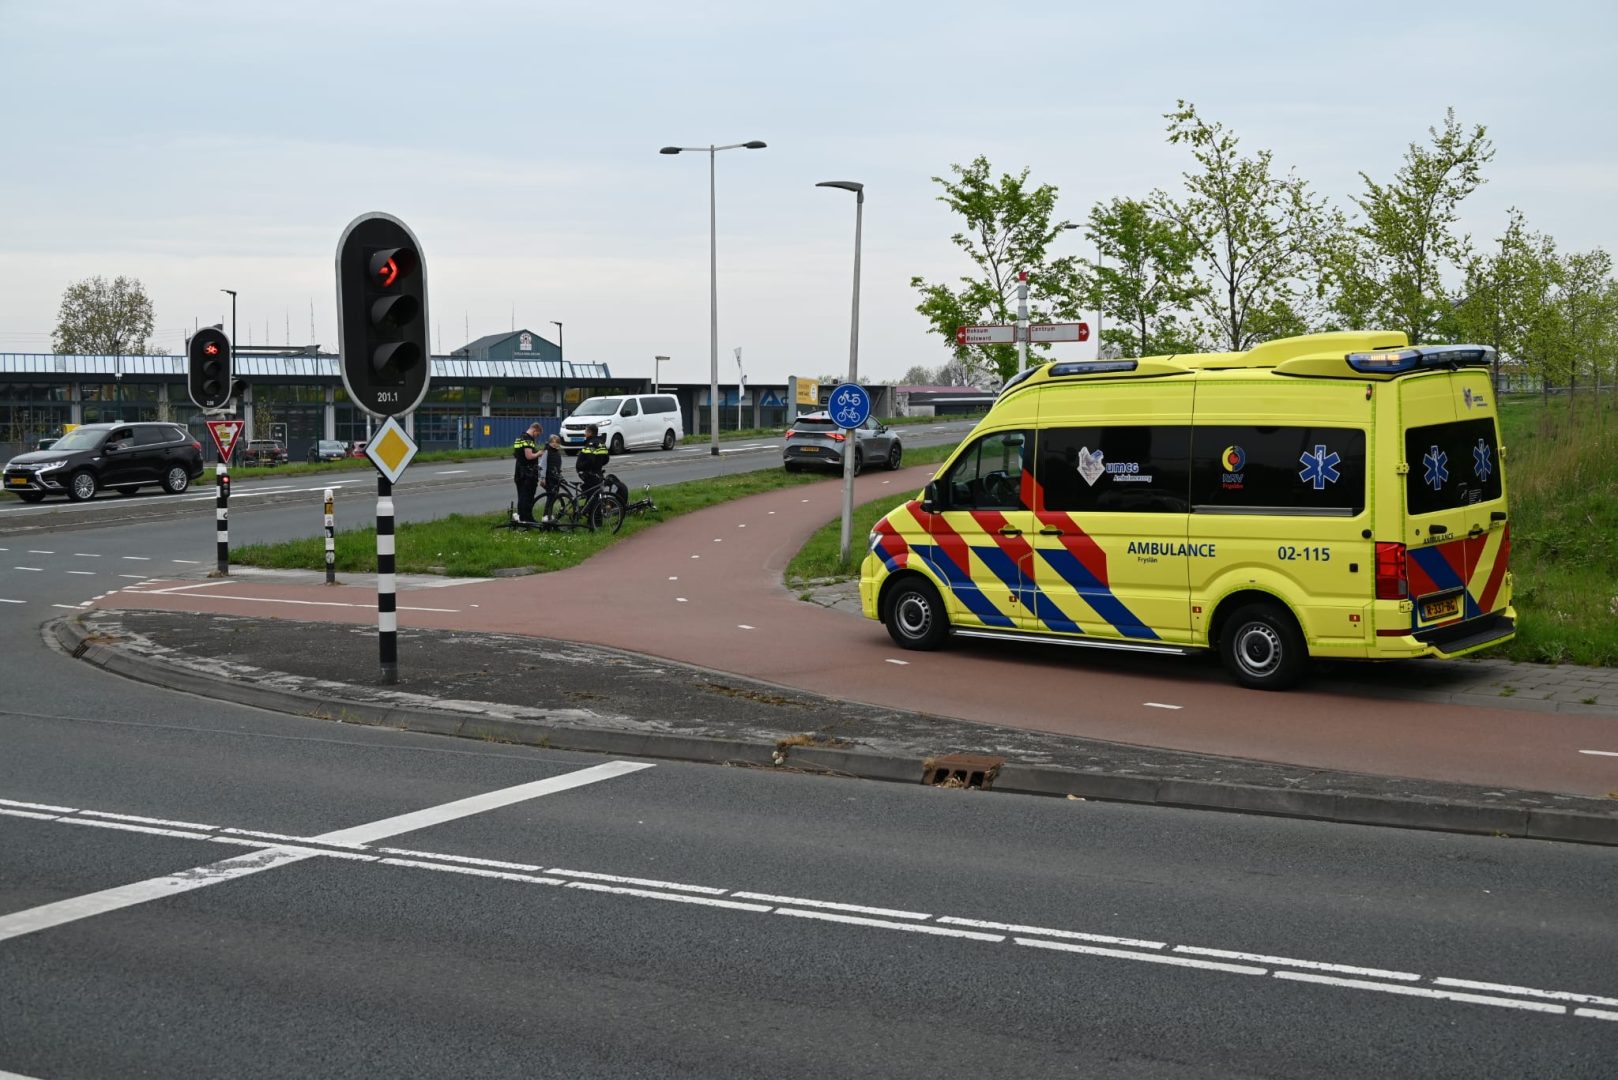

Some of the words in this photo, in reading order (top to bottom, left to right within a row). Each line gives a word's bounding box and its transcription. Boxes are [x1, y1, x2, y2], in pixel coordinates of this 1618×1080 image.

[377, 392, 398, 402] 201.1
[1423, 532, 1454, 545] AMBULANCE
[1127, 541, 1216, 557] AMBULANCE
[1277, 546, 1330, 562] 02-115
